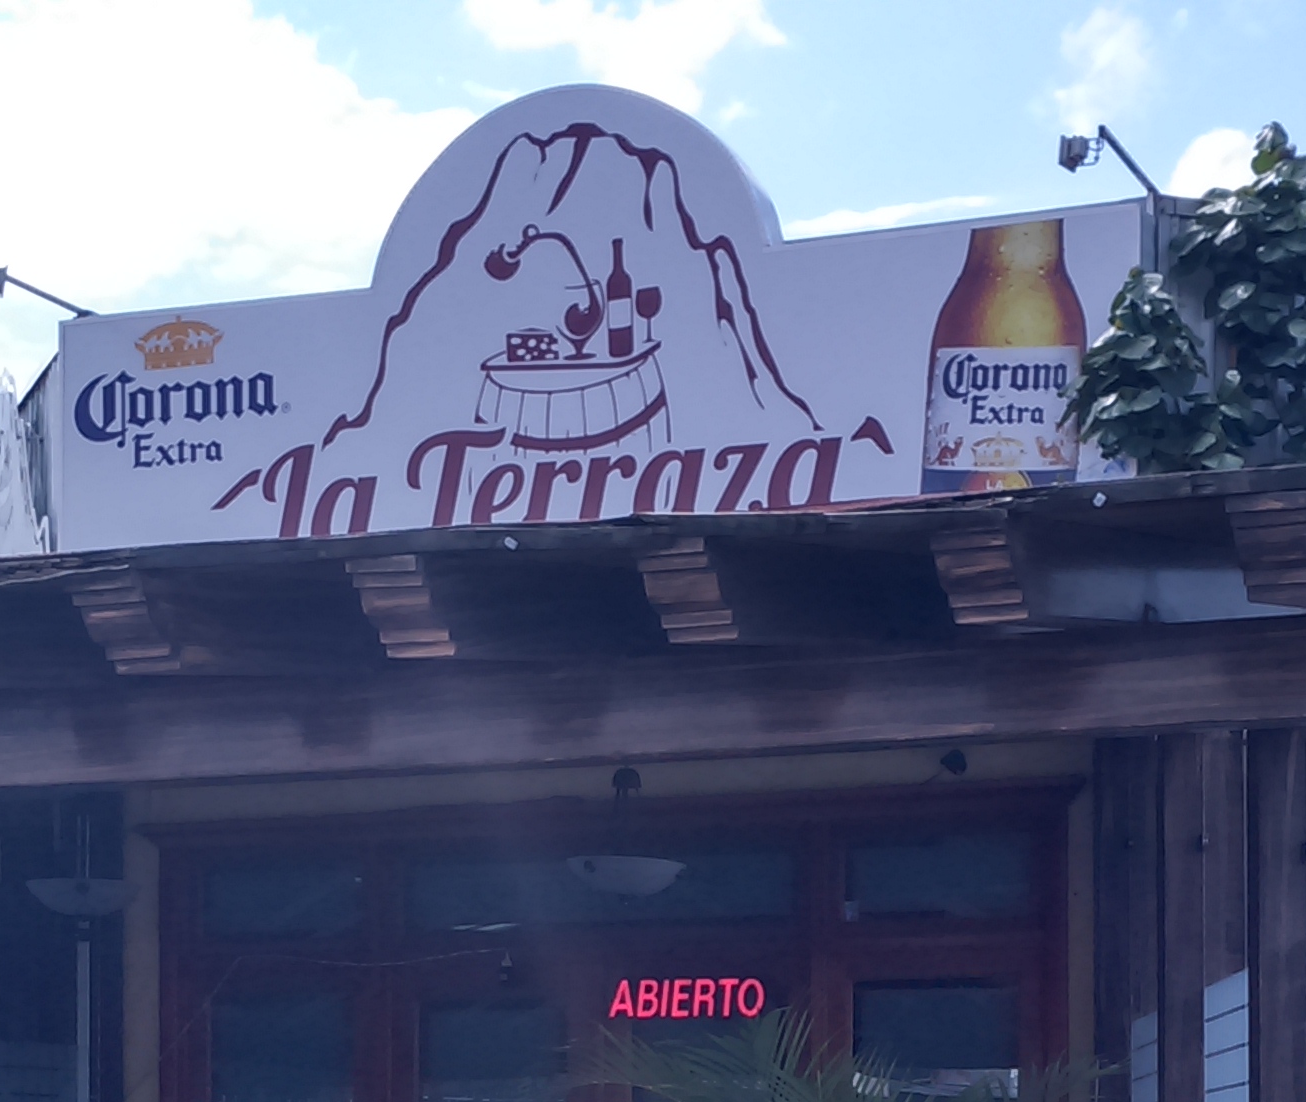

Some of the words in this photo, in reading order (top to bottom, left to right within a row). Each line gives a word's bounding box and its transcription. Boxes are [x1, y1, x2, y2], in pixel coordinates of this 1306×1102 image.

[943, 352, 1068, 404] Corona
[74, 369, 279, 449] Corona
[969, 394, 1045, 425] Extra
[132, 432, 223, 469] Extra
[405, 426, 844, 529] Terraza
[608, 978, 766, 1019] ABIERTO
